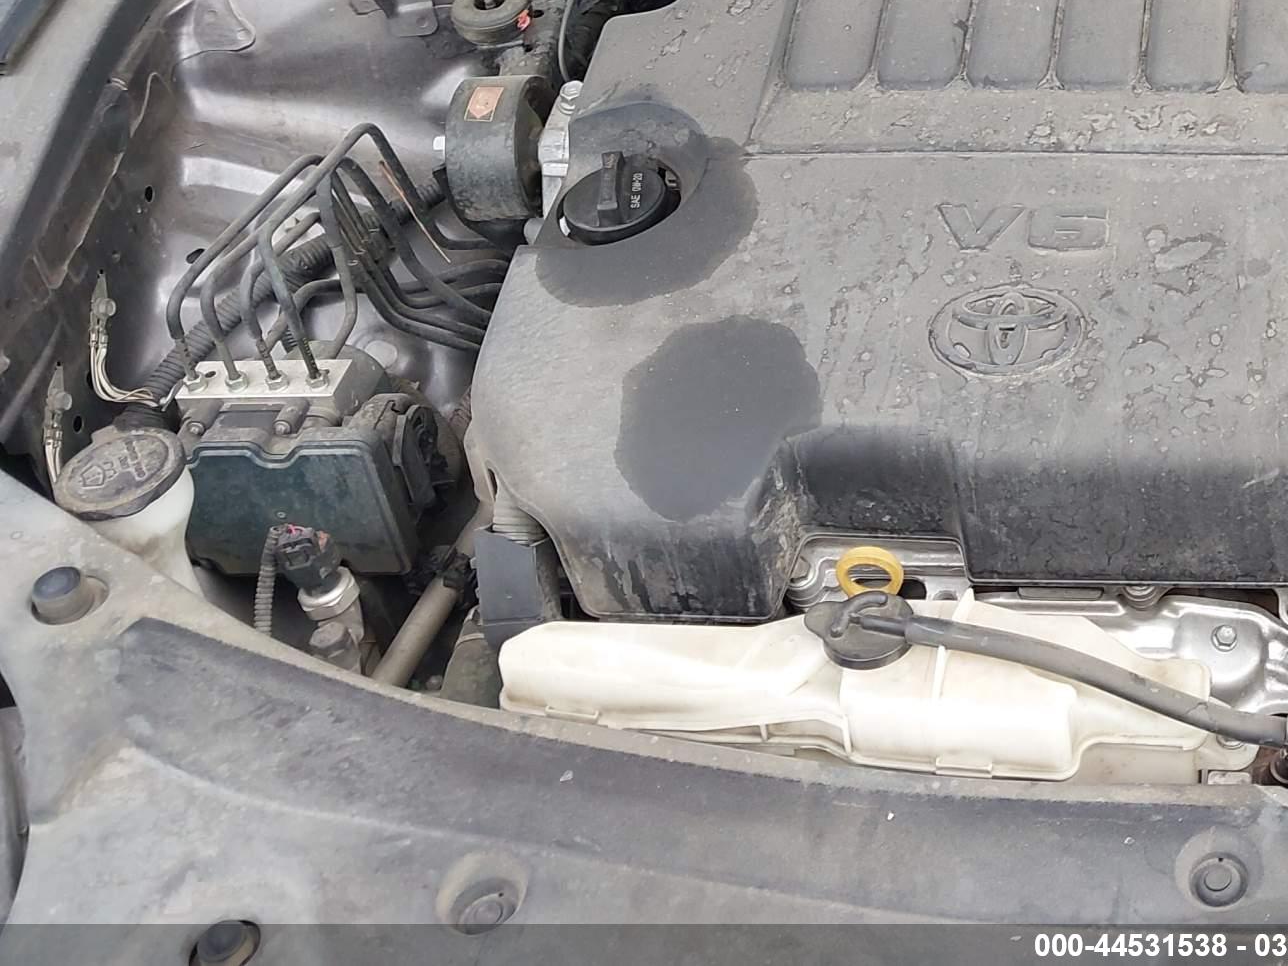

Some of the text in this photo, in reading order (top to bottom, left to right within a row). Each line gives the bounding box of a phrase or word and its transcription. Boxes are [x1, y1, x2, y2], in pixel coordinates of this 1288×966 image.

[630, 172, 643, 209] SAE 0W-20
[935, 202, 1110, 253] V6
